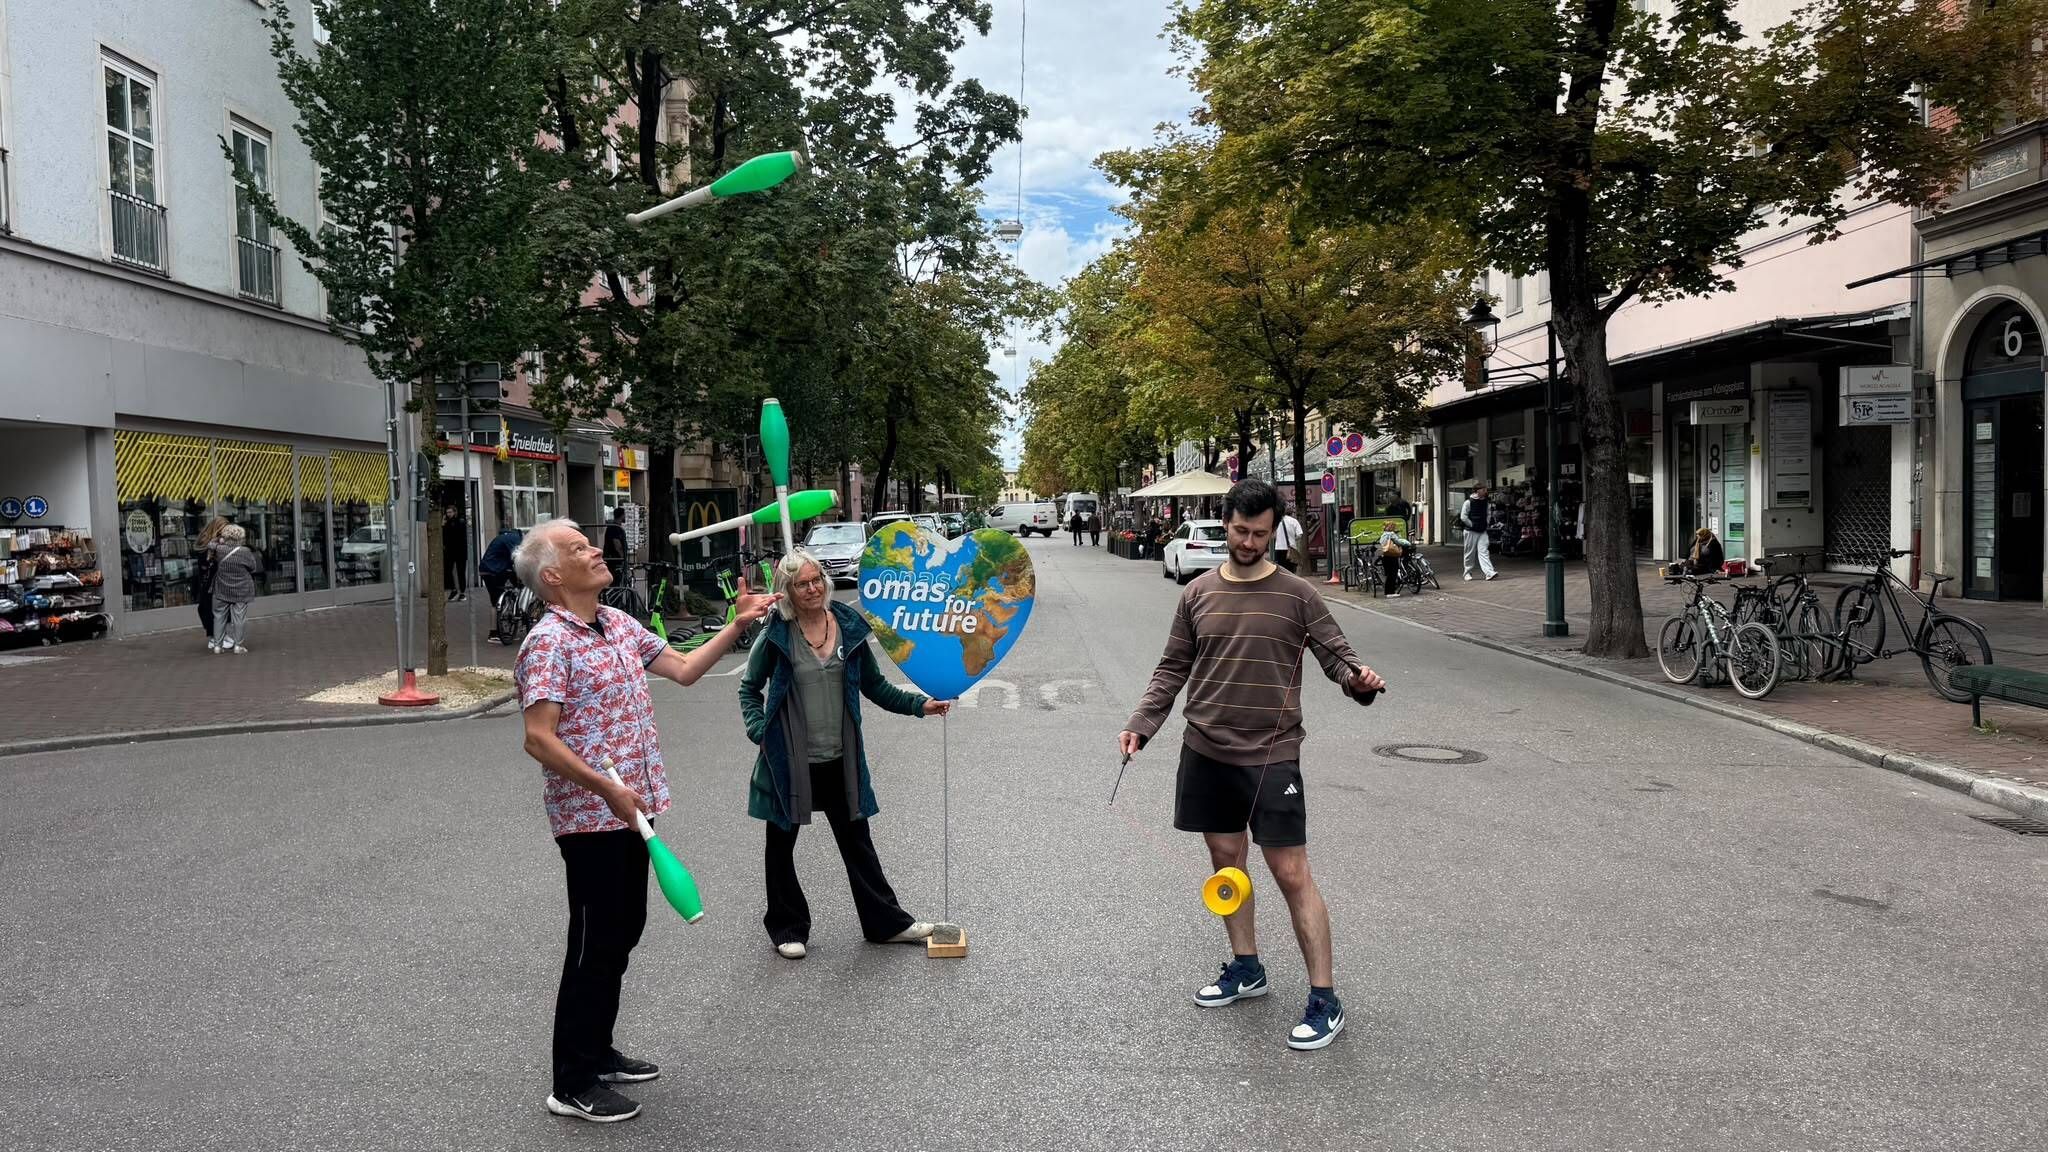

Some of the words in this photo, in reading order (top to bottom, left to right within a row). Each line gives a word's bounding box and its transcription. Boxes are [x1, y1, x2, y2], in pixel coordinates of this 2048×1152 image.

[2004, 316, 2022, 356] 6
[511, 432, 555, 454] Spielothek
[1710, 444, 1720, 474] 8
[863, 578, 946, 603] omas
[878, 569, 951, 597] opas
[944, 594, 976, 614] for
[891, 606, 978, 634] future
